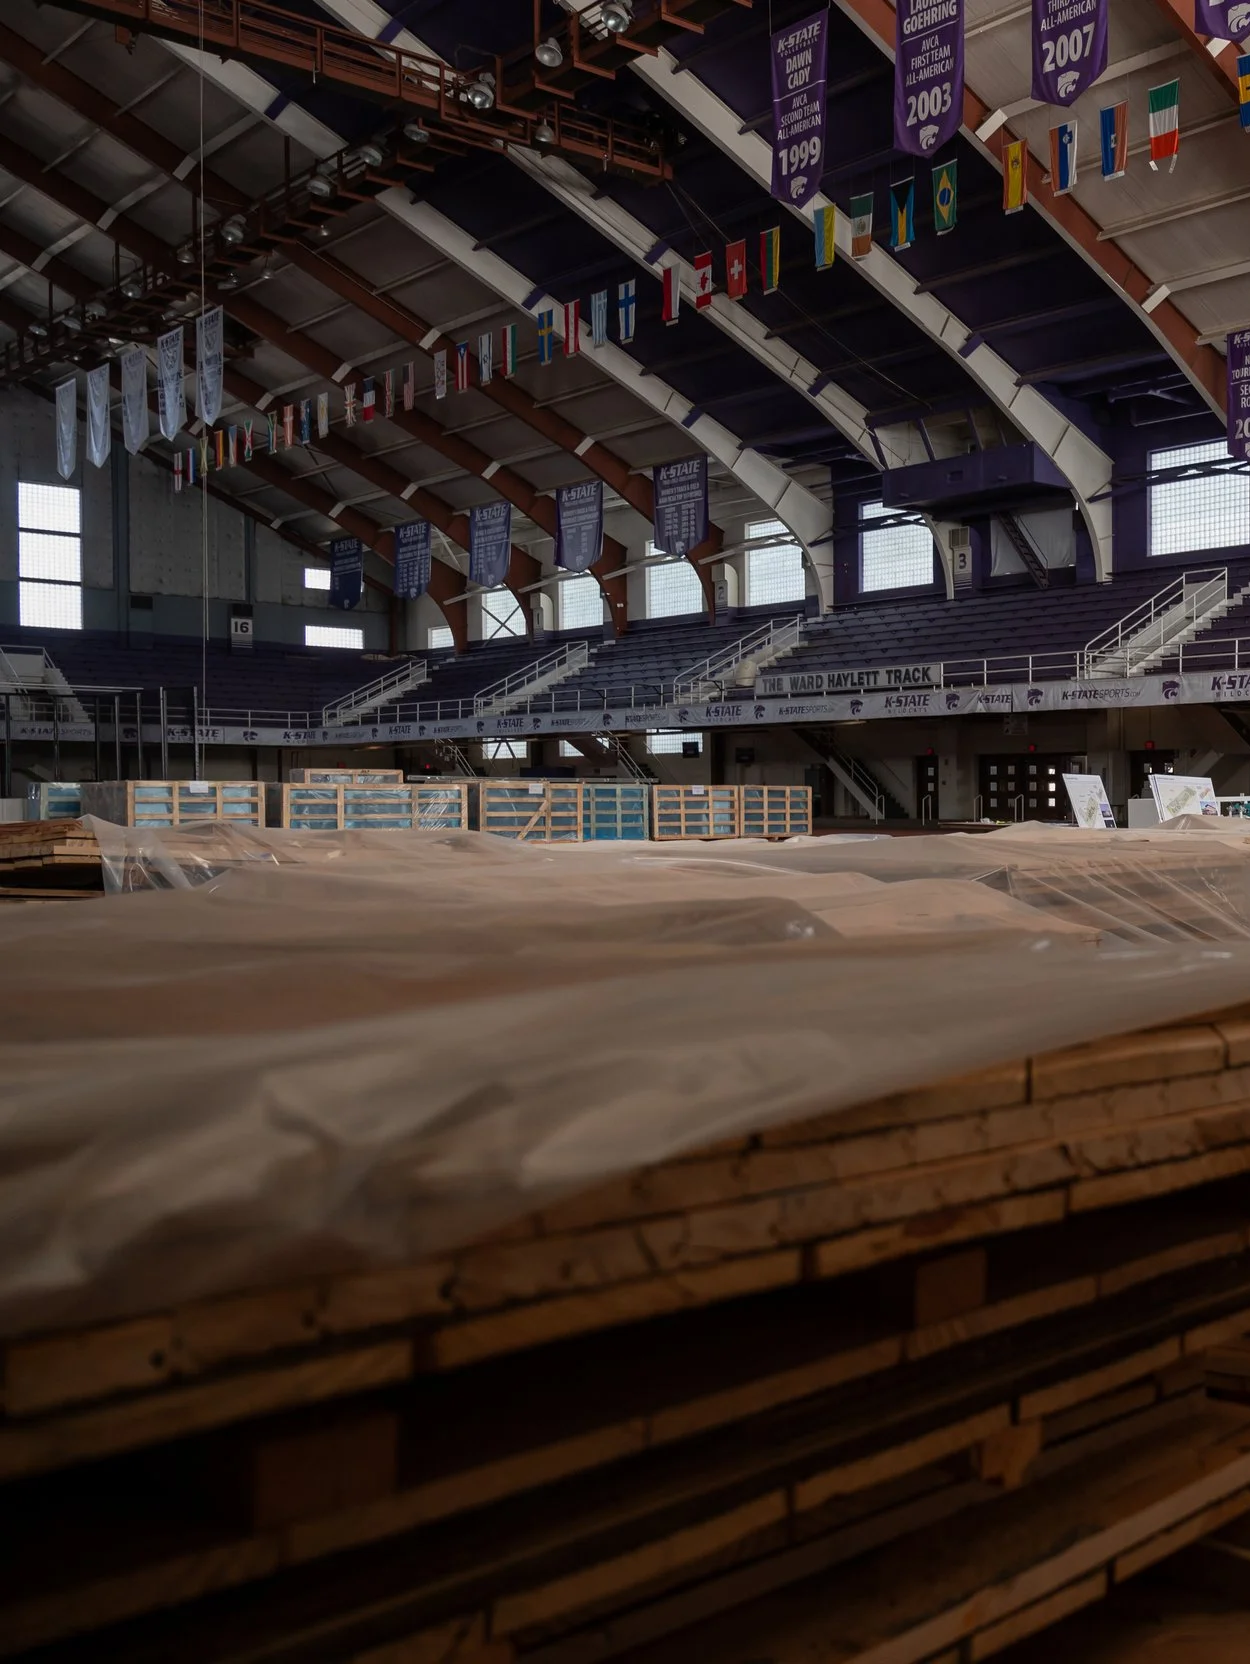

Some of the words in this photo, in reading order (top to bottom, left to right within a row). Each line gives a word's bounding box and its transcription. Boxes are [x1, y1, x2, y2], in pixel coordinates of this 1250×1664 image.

[903, 0, 957, 34] GOEHRING
[1040, 0, 1096, 31] ALL-AMERICAN
[777, 20, 821, 53] K-STATE
[921, 35, 940, 52] AVCA
[1042, 21, 1096, 74] 2007
[786, 48, 812, 74] DAWN
[911, 52, 929, 70] FIRST
[930, 44, 950, 64] TEAM
[788, 66, 810, 89] CADY
[906, 57, 954, 87] ALL-AMERICAN
[781, 108, 802, 127] SECOND
[804, 100, 820, 118] TEAM
[792, 93, 808, 109] AVCA
[906, 82, 952, 127] 2003
[777, 114, 821, 140] ALL-AMERICAN
[779, 136, 821, 176] 1999
[660, 460, 700, 480] K-STATE
[562, 484, 597, 502] K-STATE
[959, 553, 966, 569] 3
[234, 621, 249, 634] 16
[762, 677, 783, 693] THE
[790, 674, 823, 692] WARD
[828, 670, 879, 688] HAYLETT
[886, 666, 931, 684] TRACK
[706, 705, 742, 717] K-STATE
[884, 694, 930, 708] K-STATE
